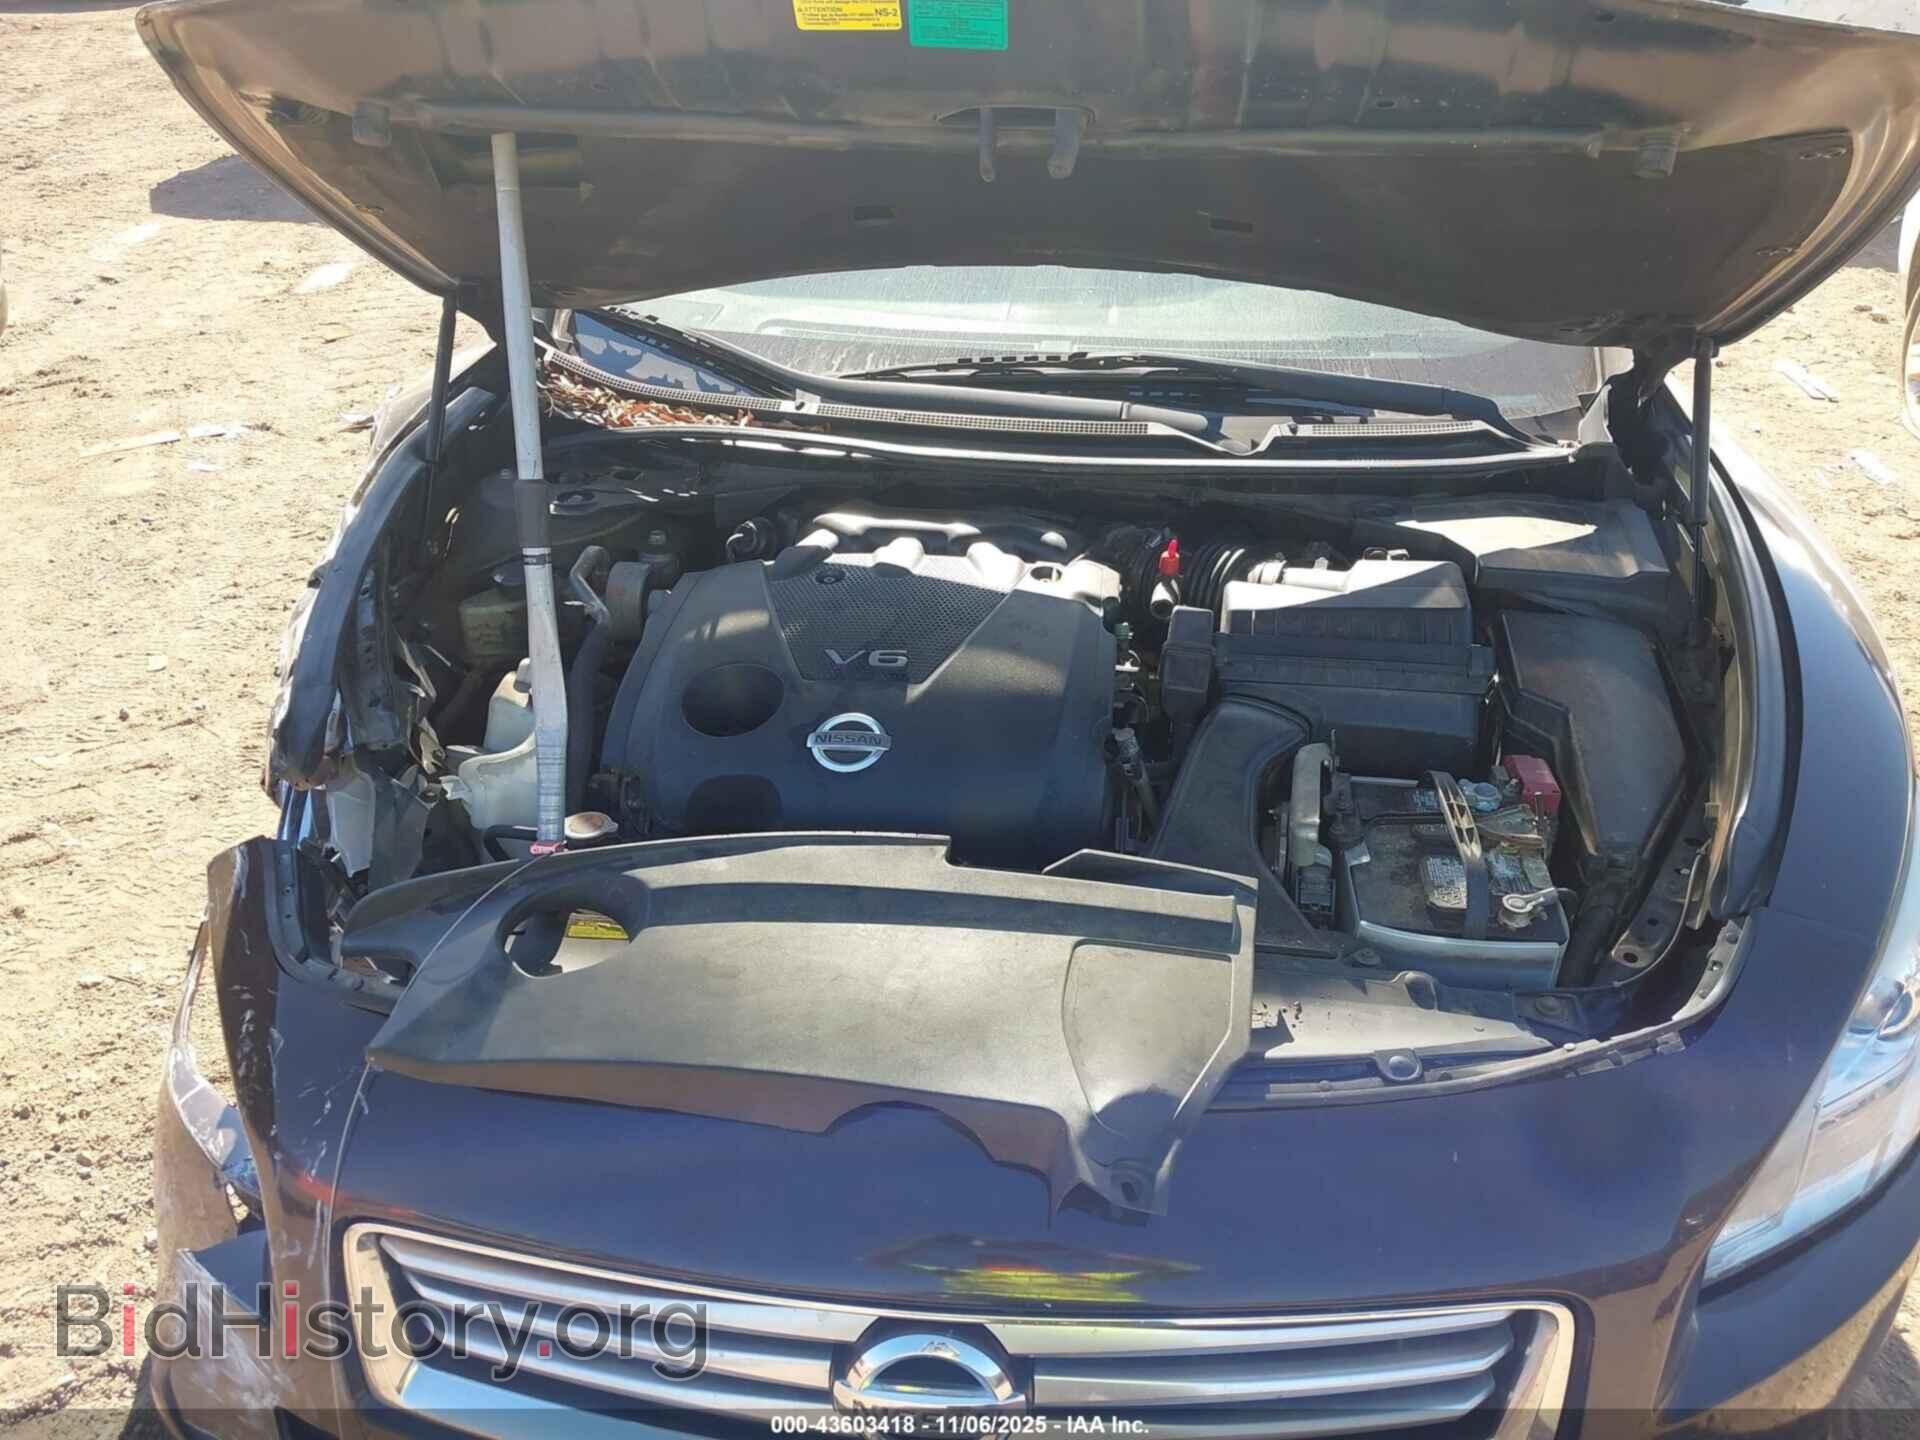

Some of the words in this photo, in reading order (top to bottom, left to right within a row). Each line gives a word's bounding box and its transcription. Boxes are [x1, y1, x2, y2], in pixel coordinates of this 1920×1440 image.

[874, 7, 898, 17] NS-2
[824, 648, 909, 667] V6
[814, 733, 882, 746] NISSAN
